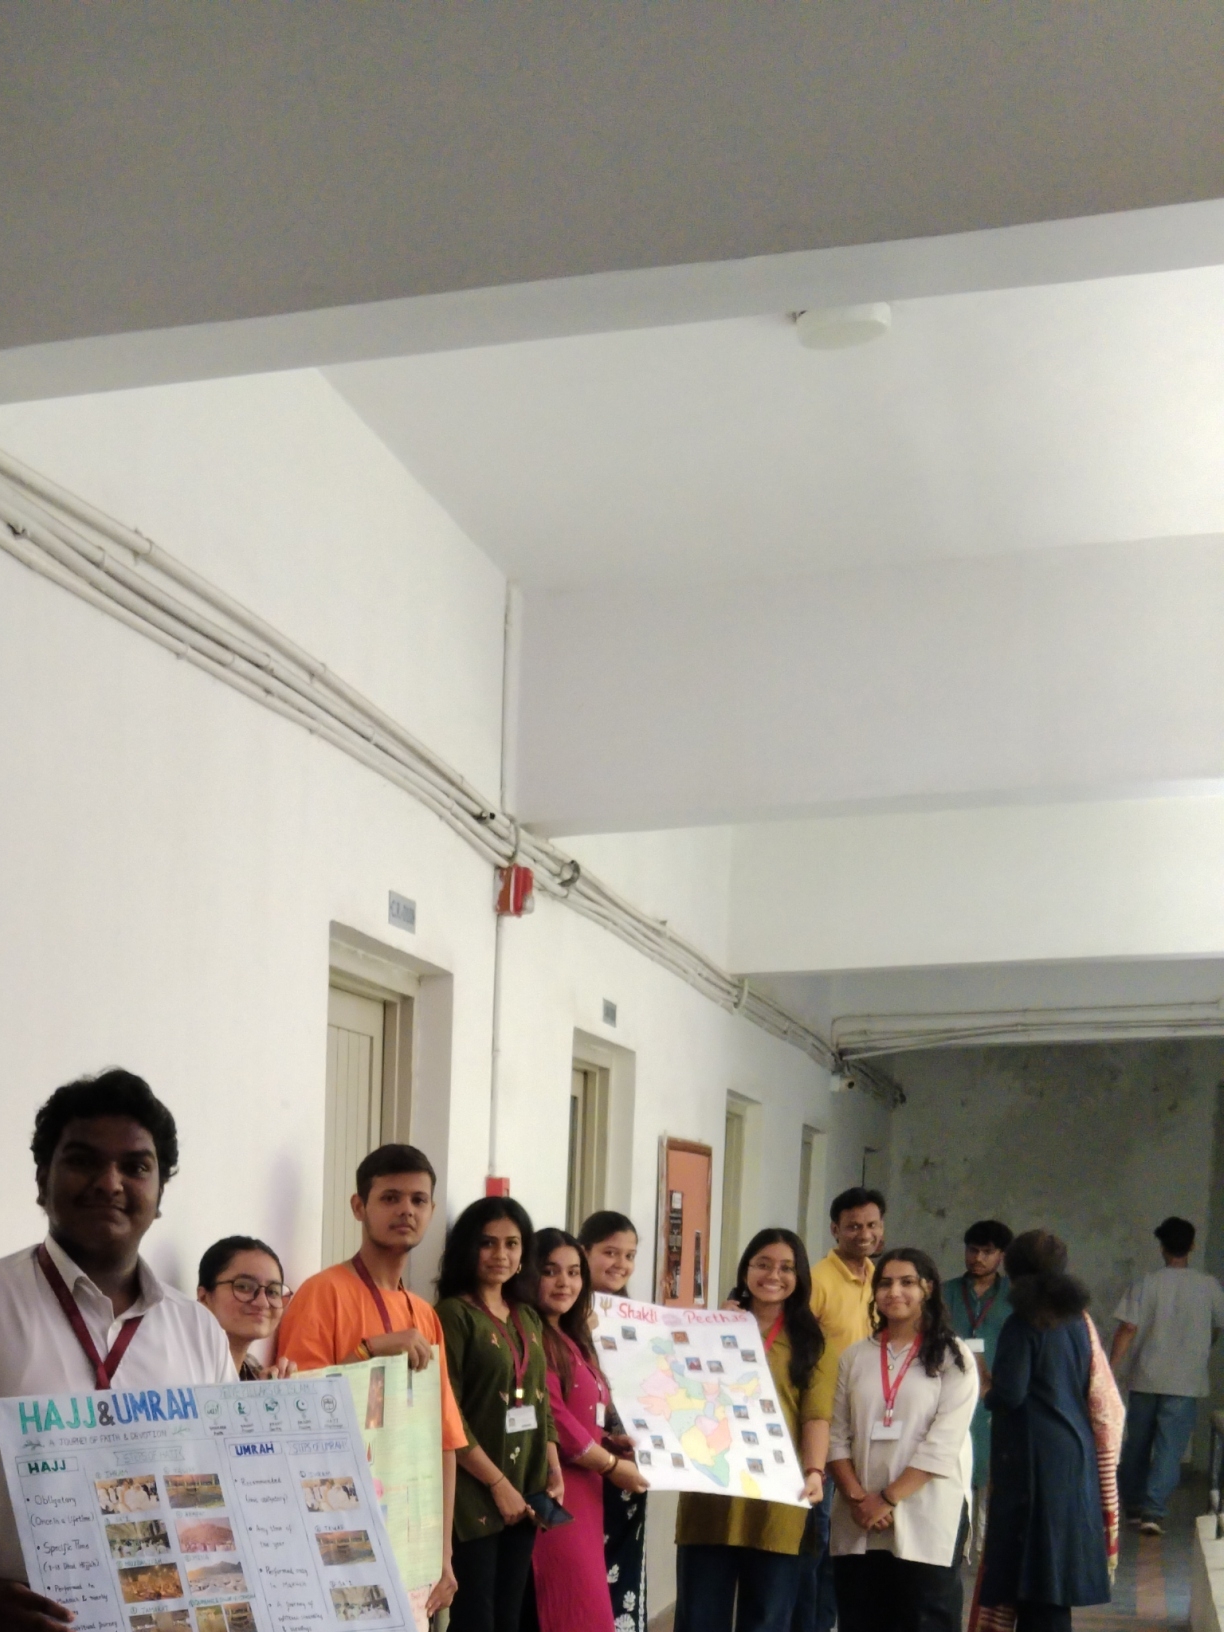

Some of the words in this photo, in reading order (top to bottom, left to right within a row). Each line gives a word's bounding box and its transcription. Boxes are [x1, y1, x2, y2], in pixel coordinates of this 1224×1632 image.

[618, 1302, 658, 1324] Shakti
[235, 1441, 275, 1456] UMRAH
[28, 1459, 67, 1474] HAJJ
